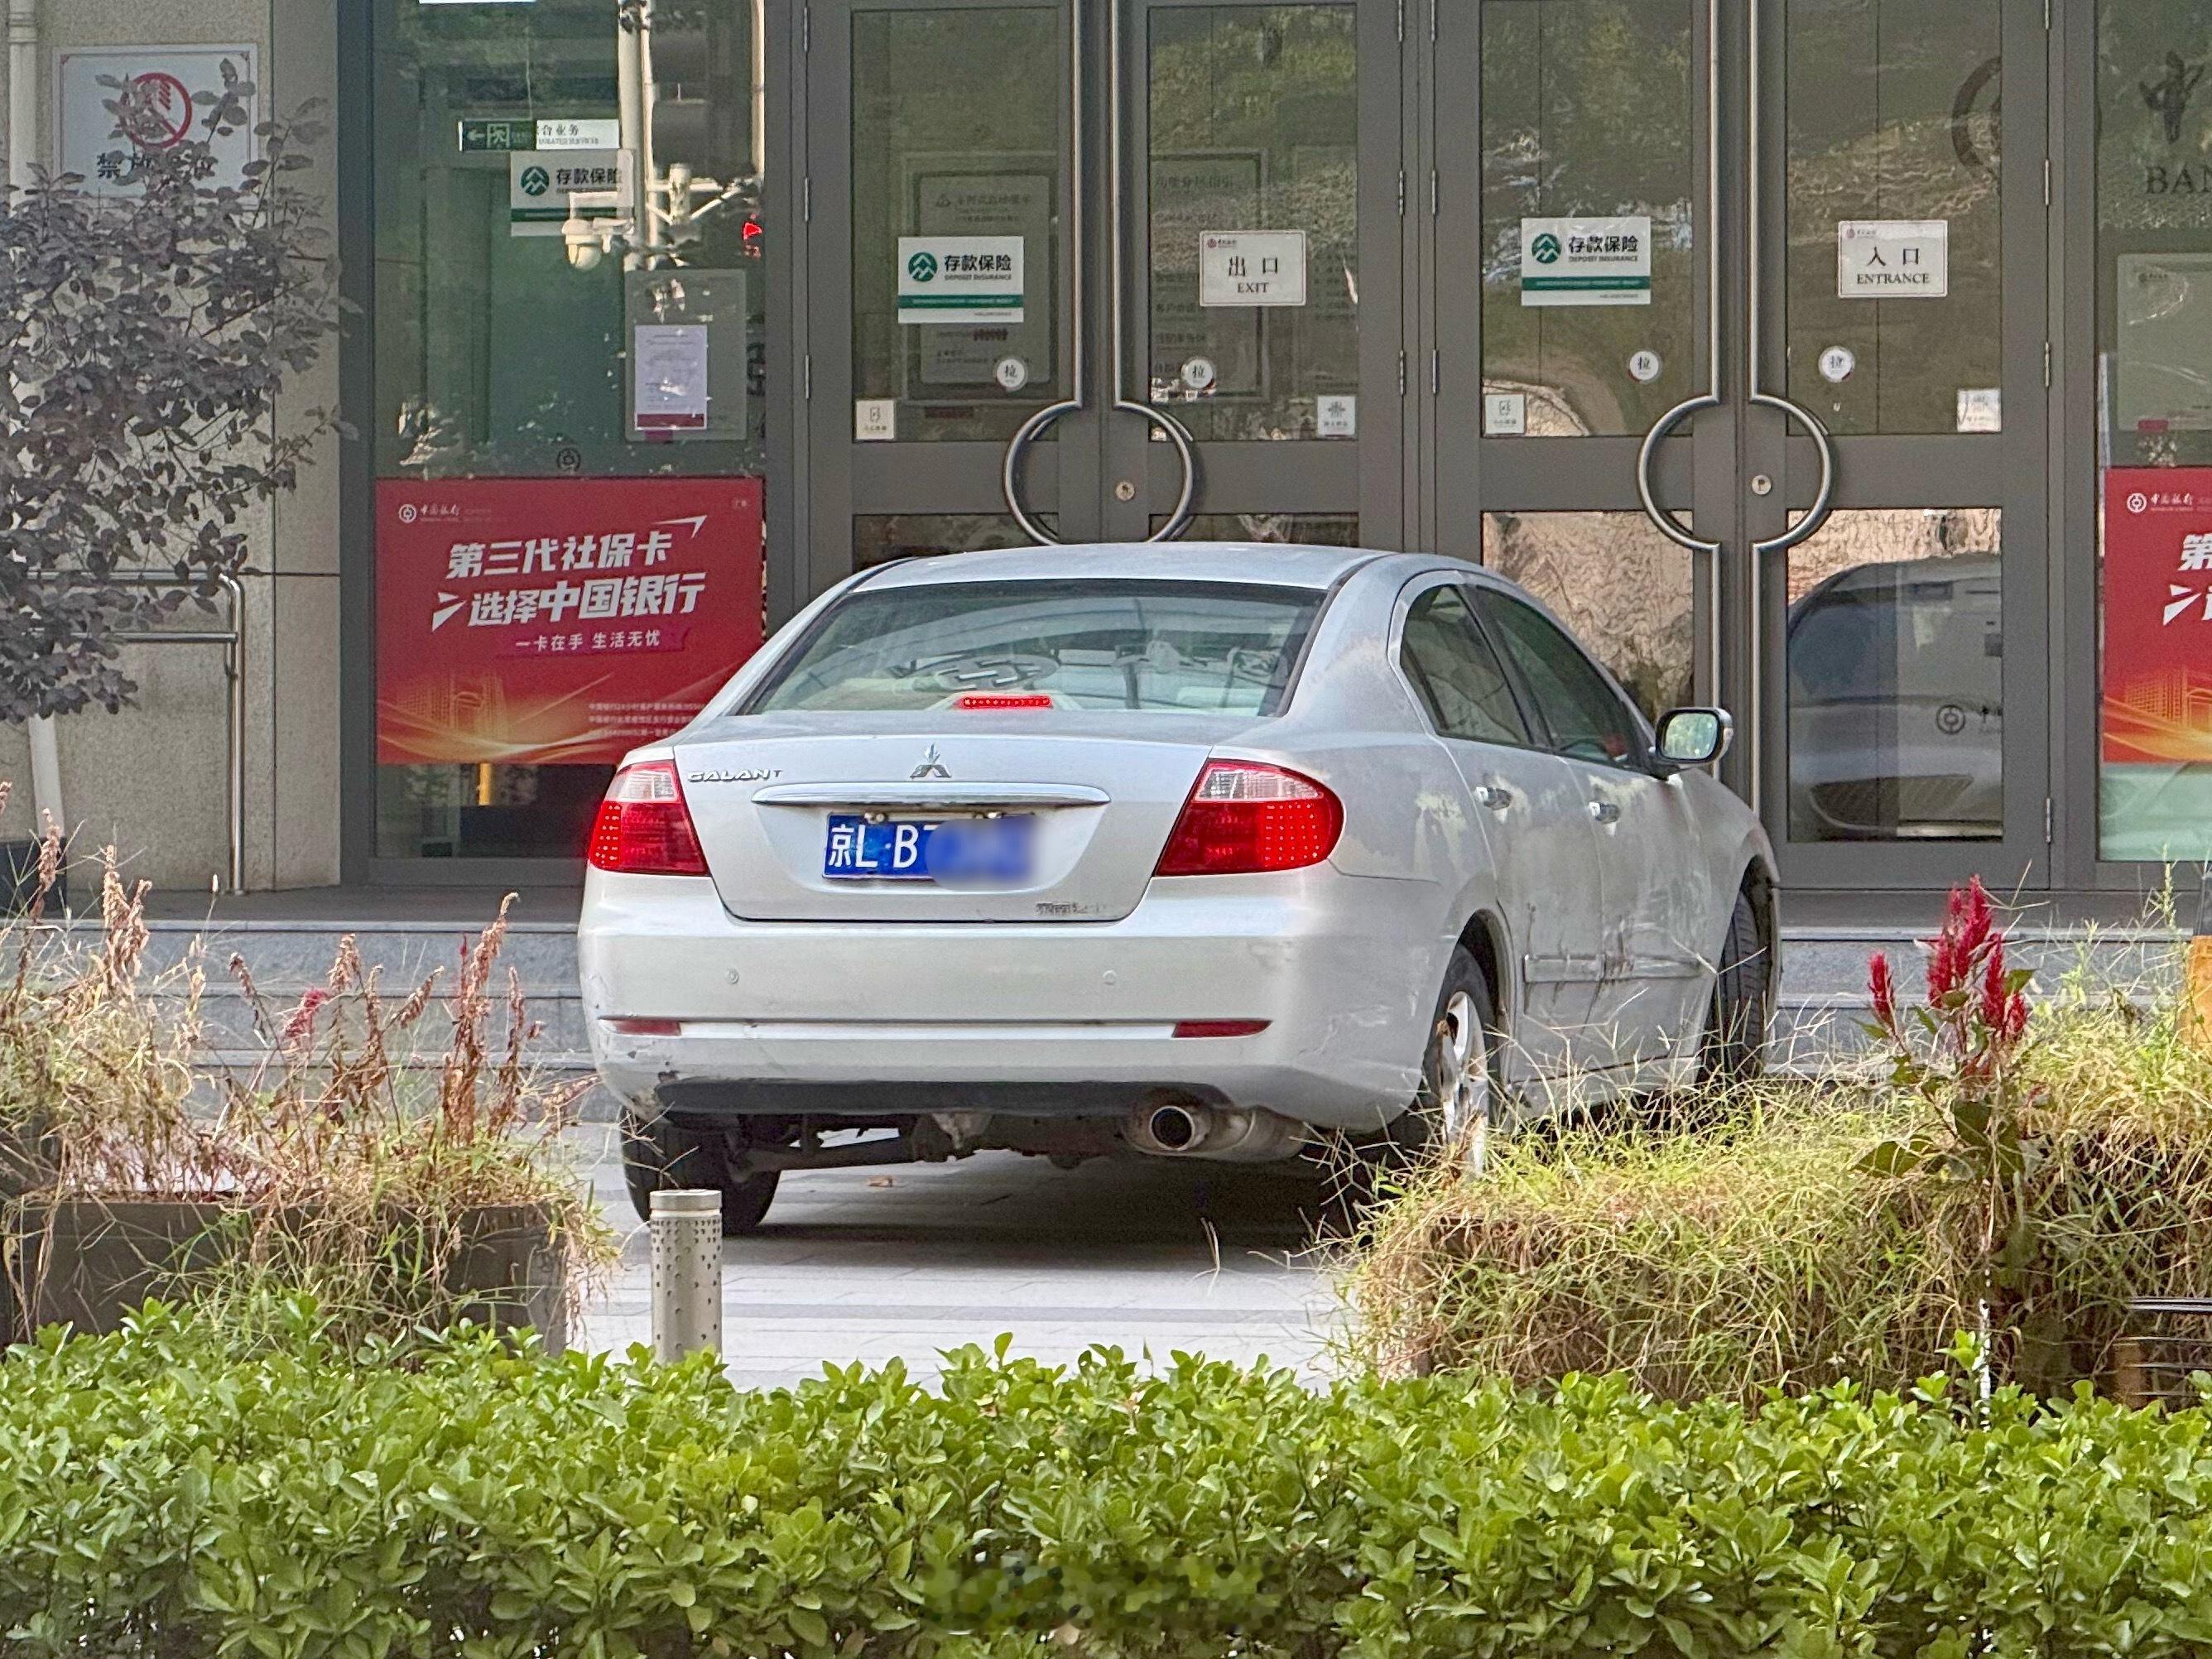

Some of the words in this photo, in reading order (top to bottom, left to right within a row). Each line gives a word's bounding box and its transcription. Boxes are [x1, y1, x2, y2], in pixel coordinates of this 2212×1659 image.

[556, 168, 623, 185] 存款保险
[1569, 235, 1639, 253] 存款保险
[944, 254, 1012, 272] 存款保险
[1866, 246, 1920, 267] 入口
[1229, 256, 1278, 277] 出口
[1237, 282, 1270, 293] EXIT
[1857, 273, 1931, 285] ENTRANCE
[1004, 364, 1017, 378] 拉
[1192, 364, 1205, 378] 拉
[1637, 356, 1651, 370] 拉
[445, 531, 673, 579] 第三代社保卡
[468, 572, 707, 627] 选择中国银行
[516, 634, 584, 652] 一卡在手
[593, 630, 661, 650] 生活无忧
[687, 768, 784, 783] GALANT
